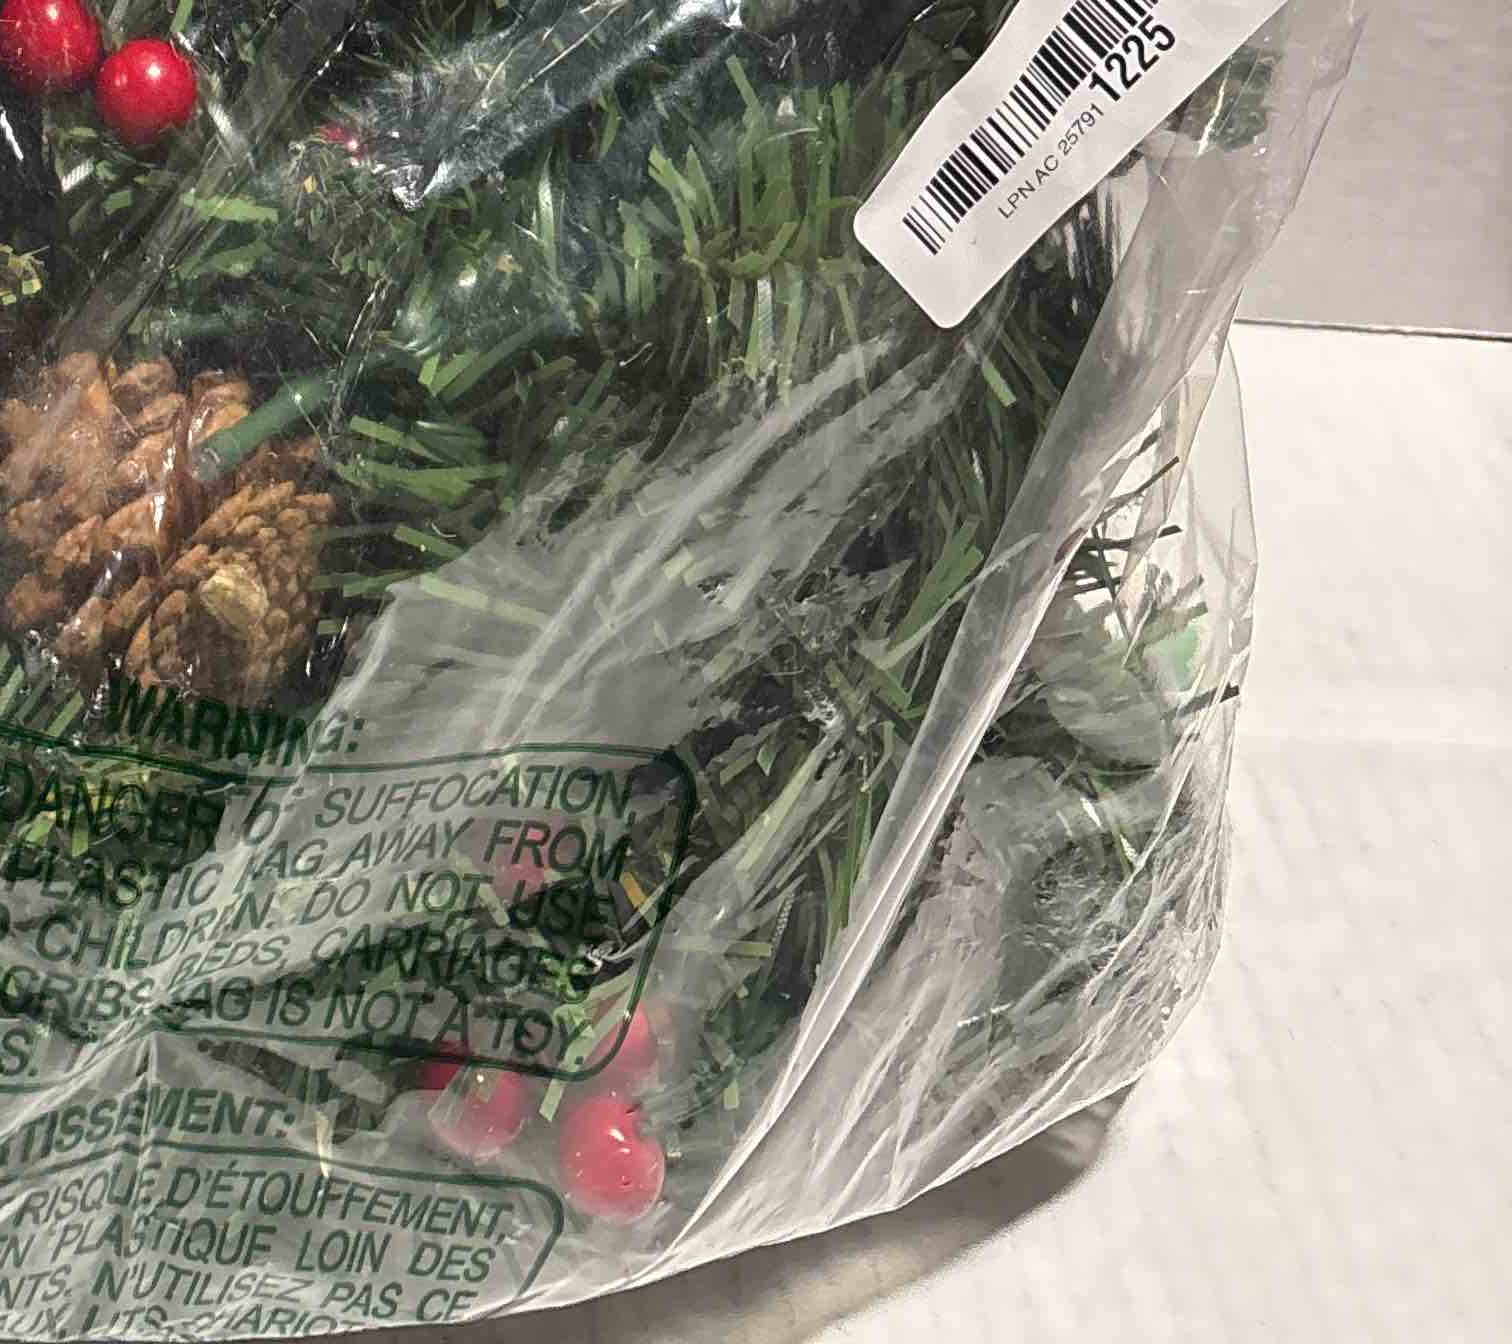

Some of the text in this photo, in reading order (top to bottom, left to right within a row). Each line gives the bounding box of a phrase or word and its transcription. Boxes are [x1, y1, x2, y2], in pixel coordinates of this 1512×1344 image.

[997, 14, 1177, 220] LPN AC 25791 1225
[313, 764, 638, 830] SUFFOCATION,
[234, 839, 329, 894] AG
[330, 816, 475, 880] AWAY
[484, 818, 633, 881] FROM
[37, 889, 274, 971] CHILDRN.
[297, 878, 372, 926] DO
[387, 869, 499, 915] NOT
[178, 976, 255, 1022] AG
[265, 976, 316, 1027] IS
[322, 986, 438, 1033] NOT
[436, 989, 474, 1044] A
[165, 1160, 508, 1246] D'ÉTOUFFEMENT,
[50, 1210, 279, 1266] PLASTIQUE
[294, 1229, 390, 1274] LOIN
[408, 1243, 498, 1283] DES
[89, 1259, 315, 1306] N'UTILISEZ
[319, 1279, 404, 1319] PAS
[416, 1288, 479, 1322] CE
